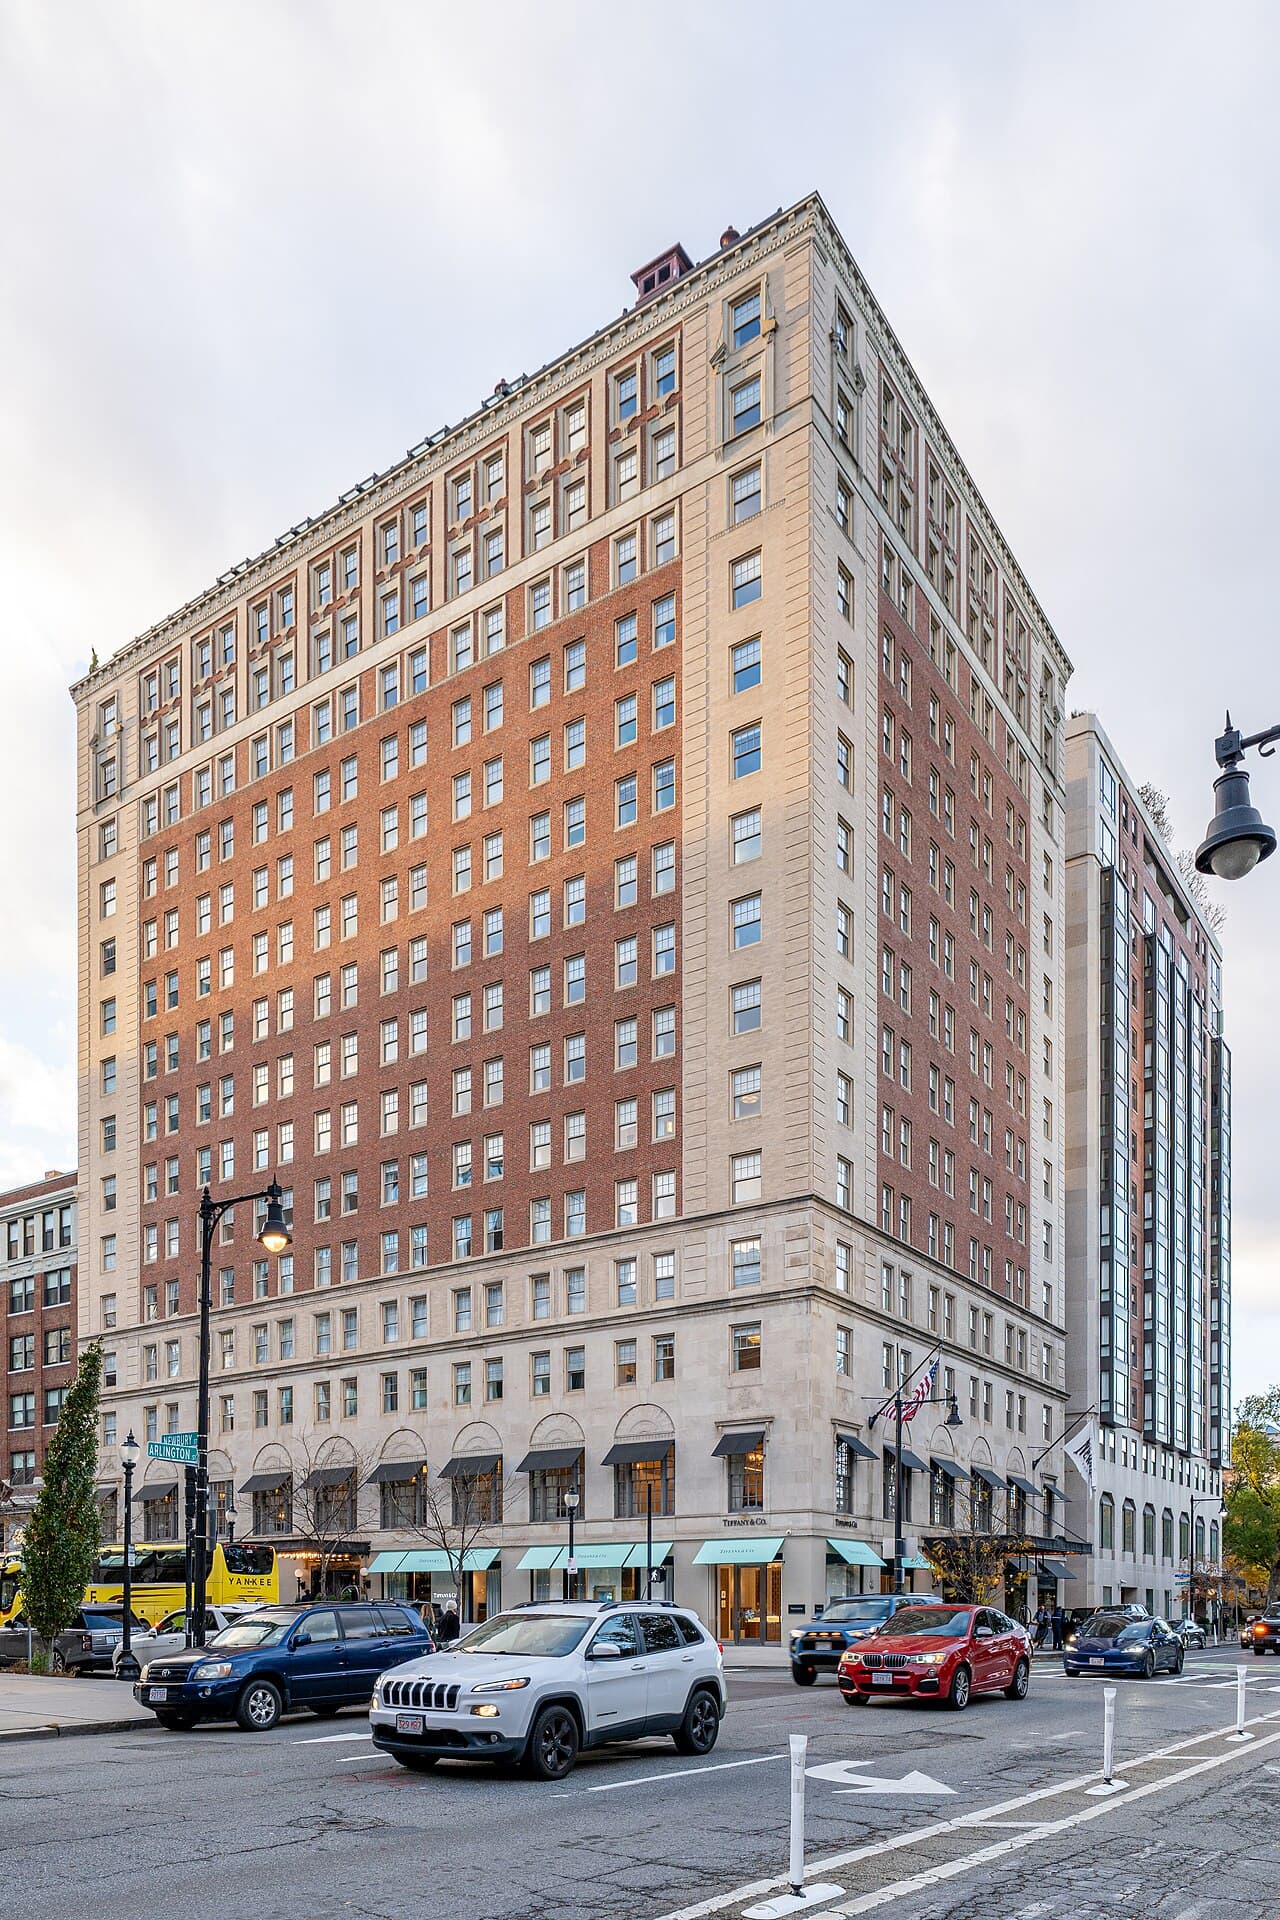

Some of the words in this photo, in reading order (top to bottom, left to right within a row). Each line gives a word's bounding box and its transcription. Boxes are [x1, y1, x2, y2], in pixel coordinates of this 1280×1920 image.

[163, 1434, 192, 1446] NEWBURY
[149, 1444, 191, 1460] ARLINGTON
[229, 1577, 271, 1586] YANKEE
